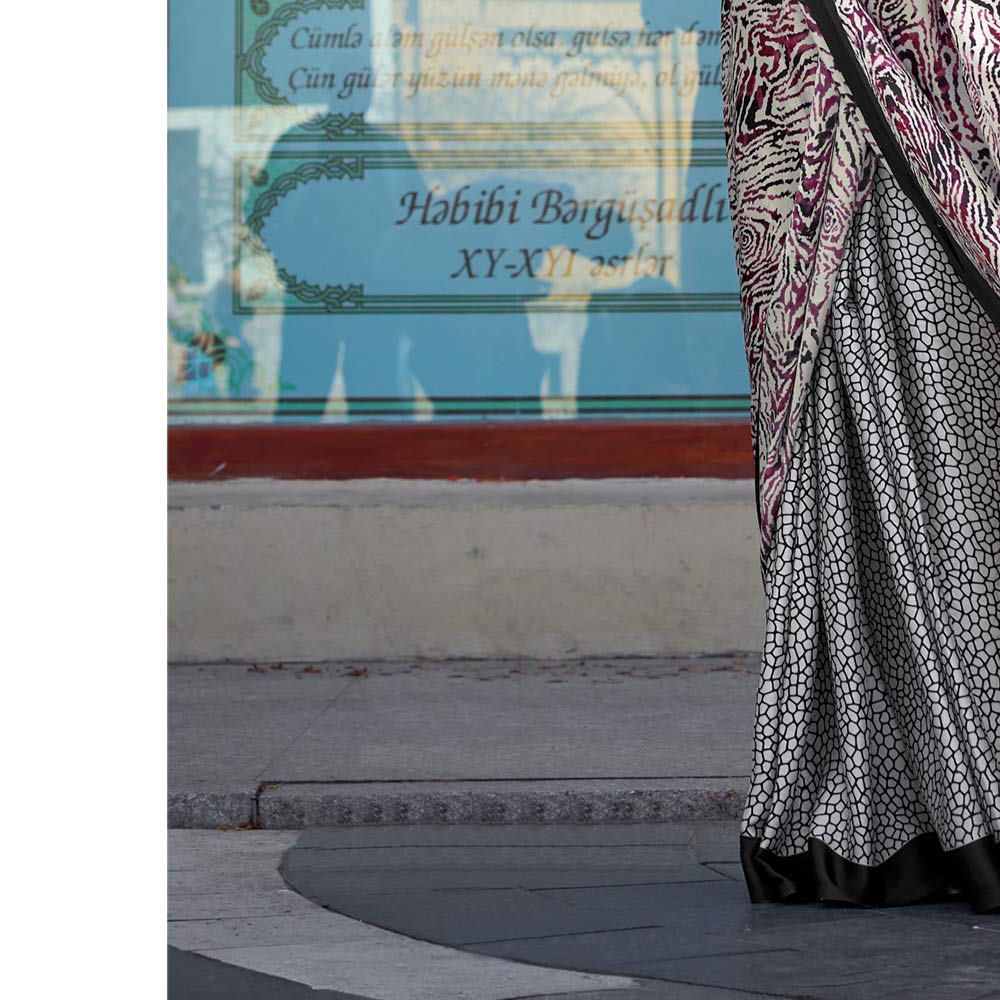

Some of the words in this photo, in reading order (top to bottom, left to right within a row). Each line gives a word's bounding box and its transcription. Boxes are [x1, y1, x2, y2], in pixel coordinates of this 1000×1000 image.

[290, 22, 363, 50] Cümlə
[424, 22, 504, 59] gülşən
[511, 21, 564, 50] olsa,
[565, 22, 631, 59] gülsə
[637, 19, 675, 48] hər
[288, 65, 337, 96] Çün
[404, 65, 481, 100] yüzün
[489, 69, 549, 89] mənə
[654, 61, 682, 89] ol
[395, 184, 522, 226] Həbibi
[530, 182, 728, 241] Bərgüşadlı
[588, 241, 675, 279] əsrlər
